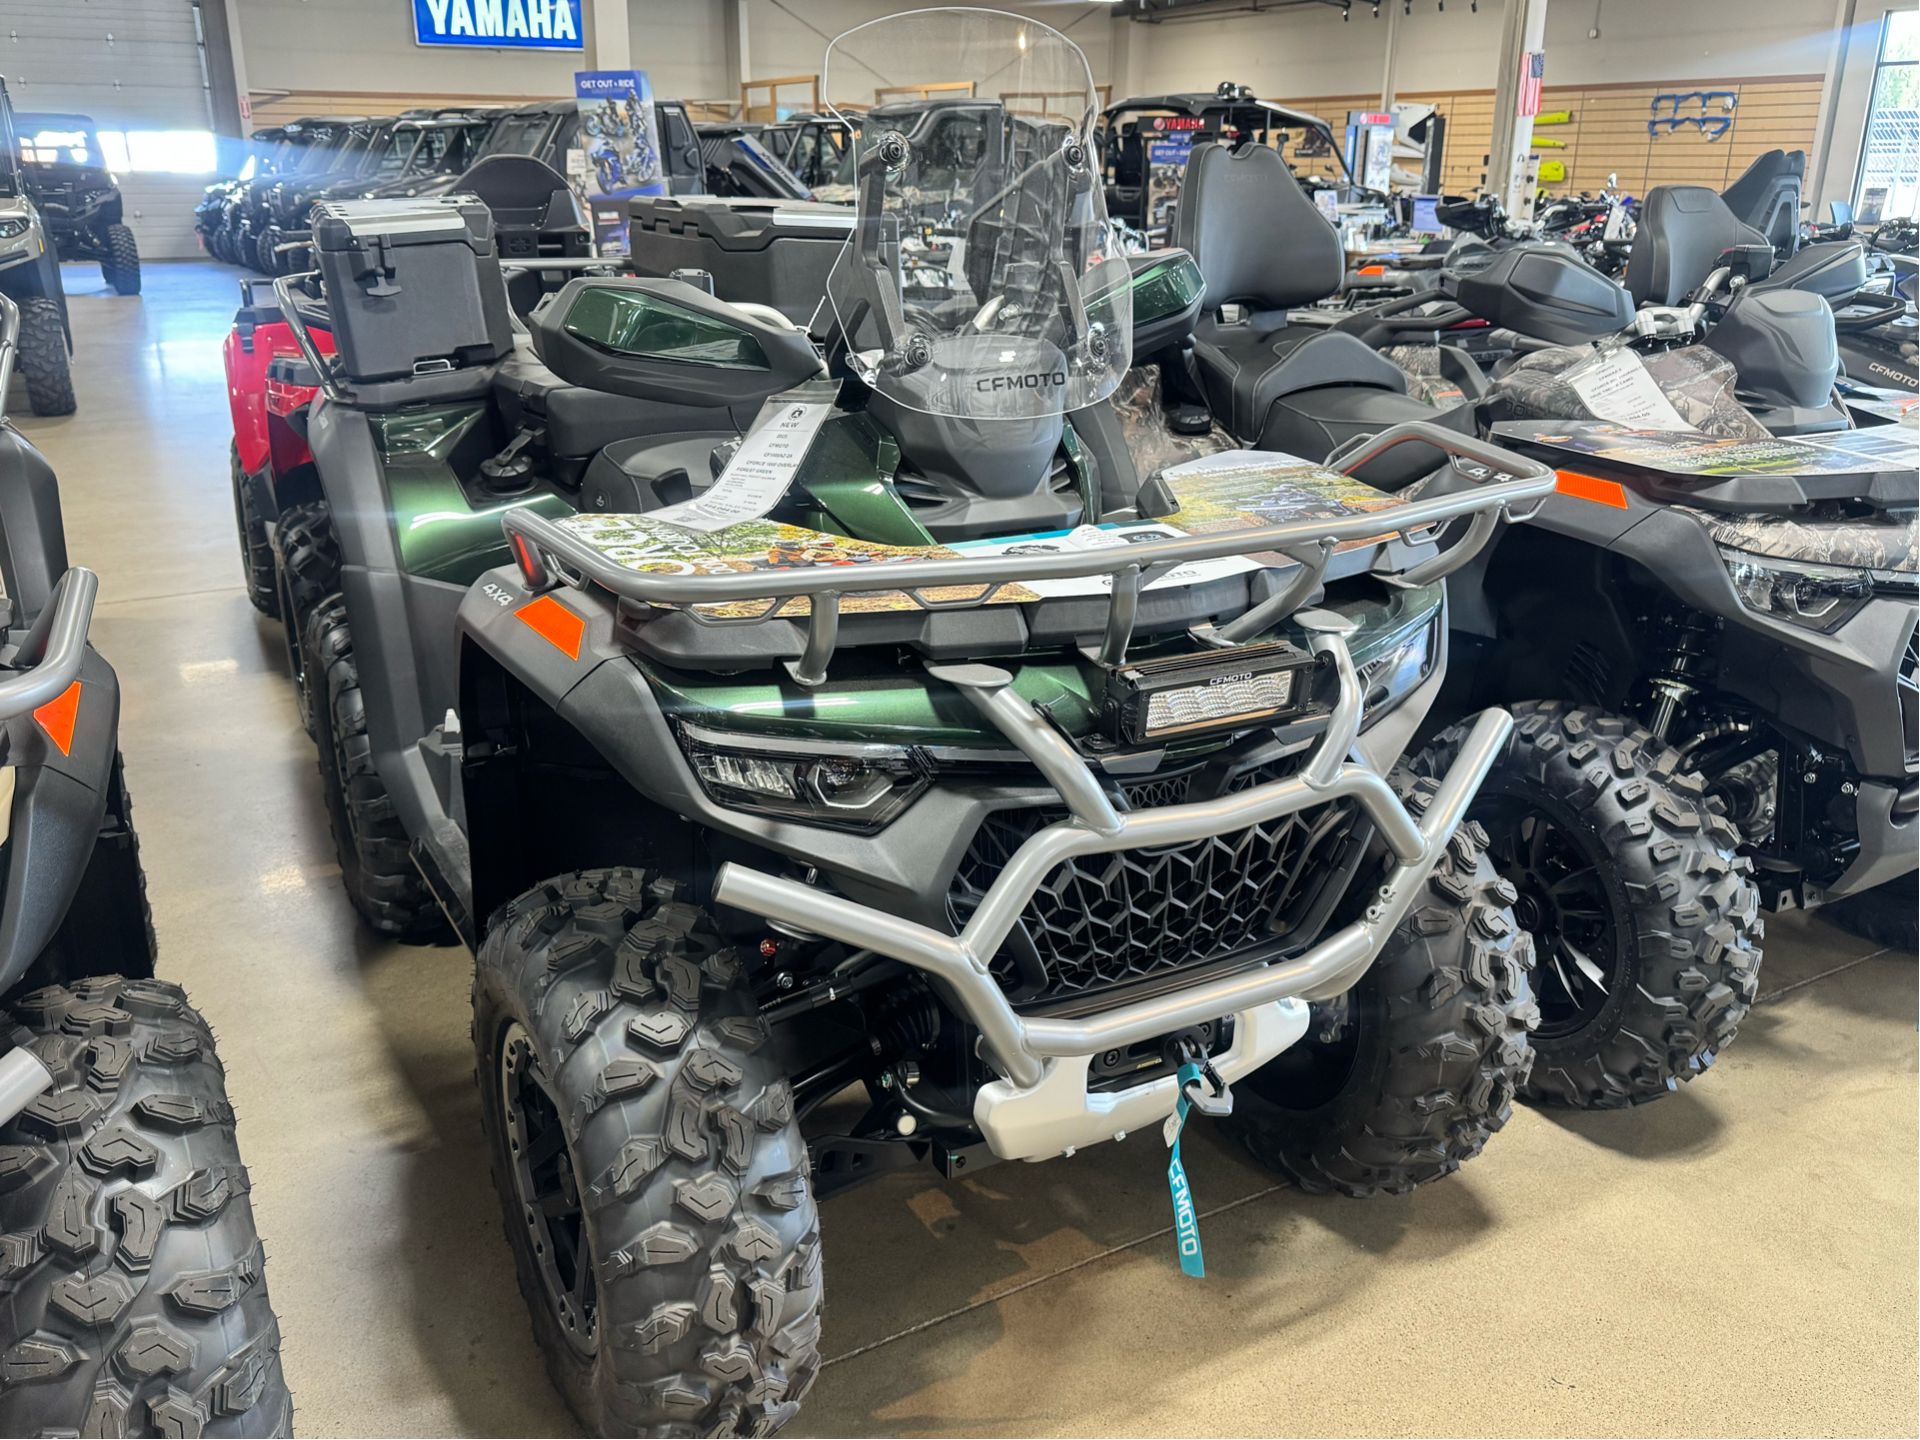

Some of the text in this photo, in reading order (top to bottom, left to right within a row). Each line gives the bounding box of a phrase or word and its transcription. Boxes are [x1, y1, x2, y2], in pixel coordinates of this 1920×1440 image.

[423, 0, 577, 40] YAMAHA
[580, 80, 597, 89] GET
[597, 79, 613, 88] OUT
[618, 79, 635, 88] RIDE
[1166, 118, 1205, 130] YAMAHA
[976, 371, 1066, 392] CFMOTO
[1867, 361, 1919, 388] CFMOTO
[1209, 672, 1253, 686] CFMOTO
[1168, 1157, 1198, 1257] CFMOTO
